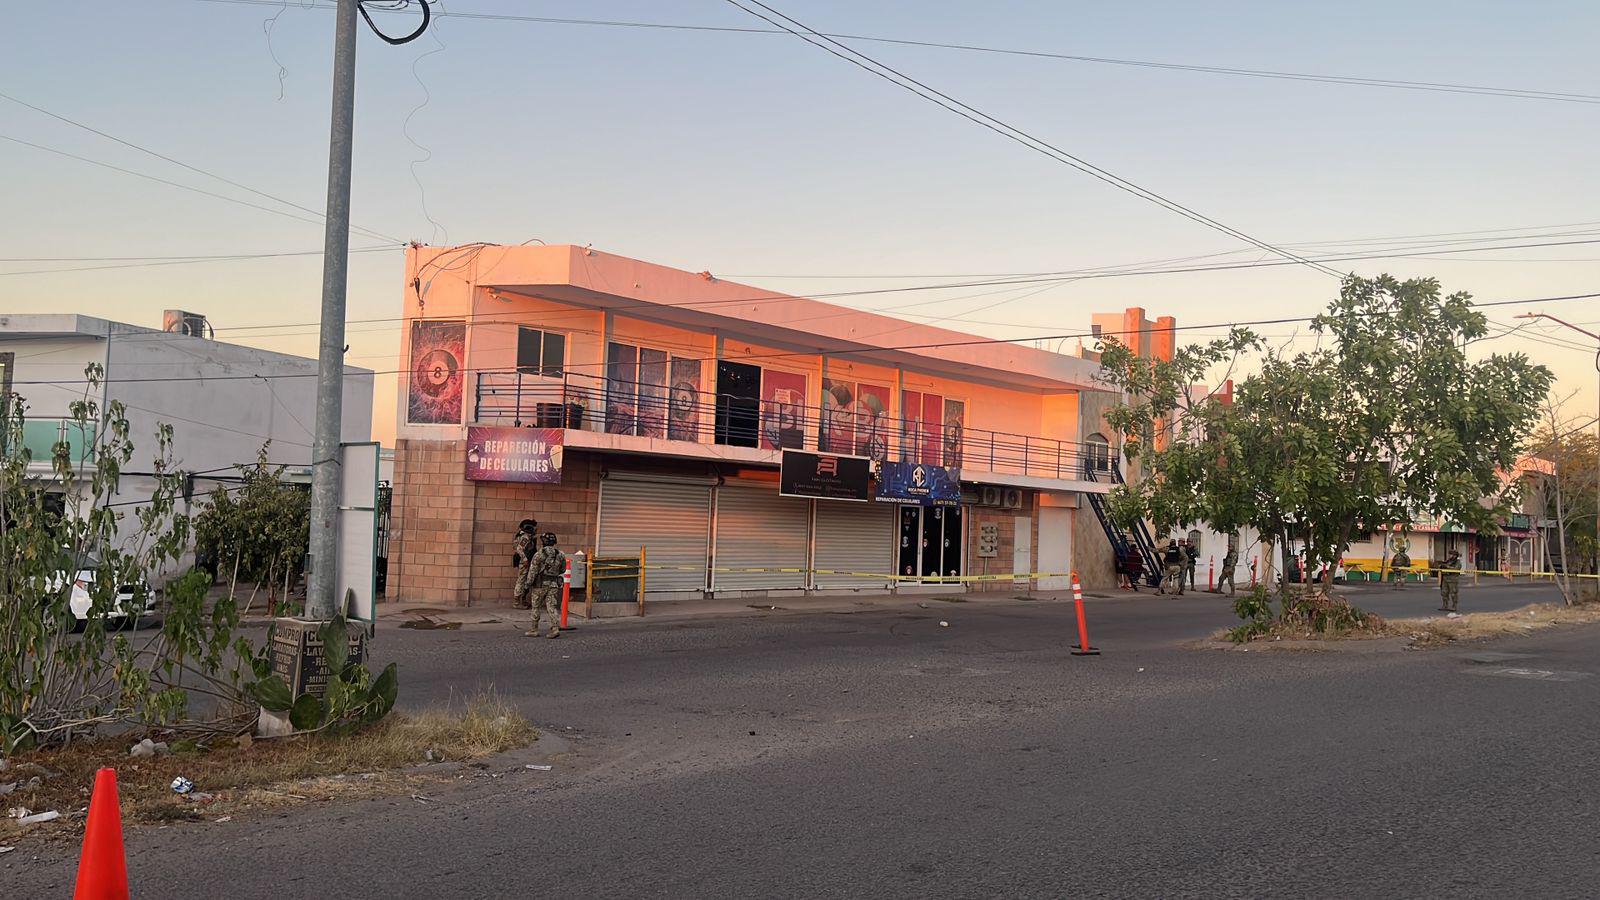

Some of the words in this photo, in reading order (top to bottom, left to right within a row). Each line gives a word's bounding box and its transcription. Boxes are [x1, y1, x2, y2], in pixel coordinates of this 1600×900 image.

[485, 440, 546, 455] REPARECIÓN
[480, 458, 491, 470] DE
[493, 458, 548, 473] CELULARES
